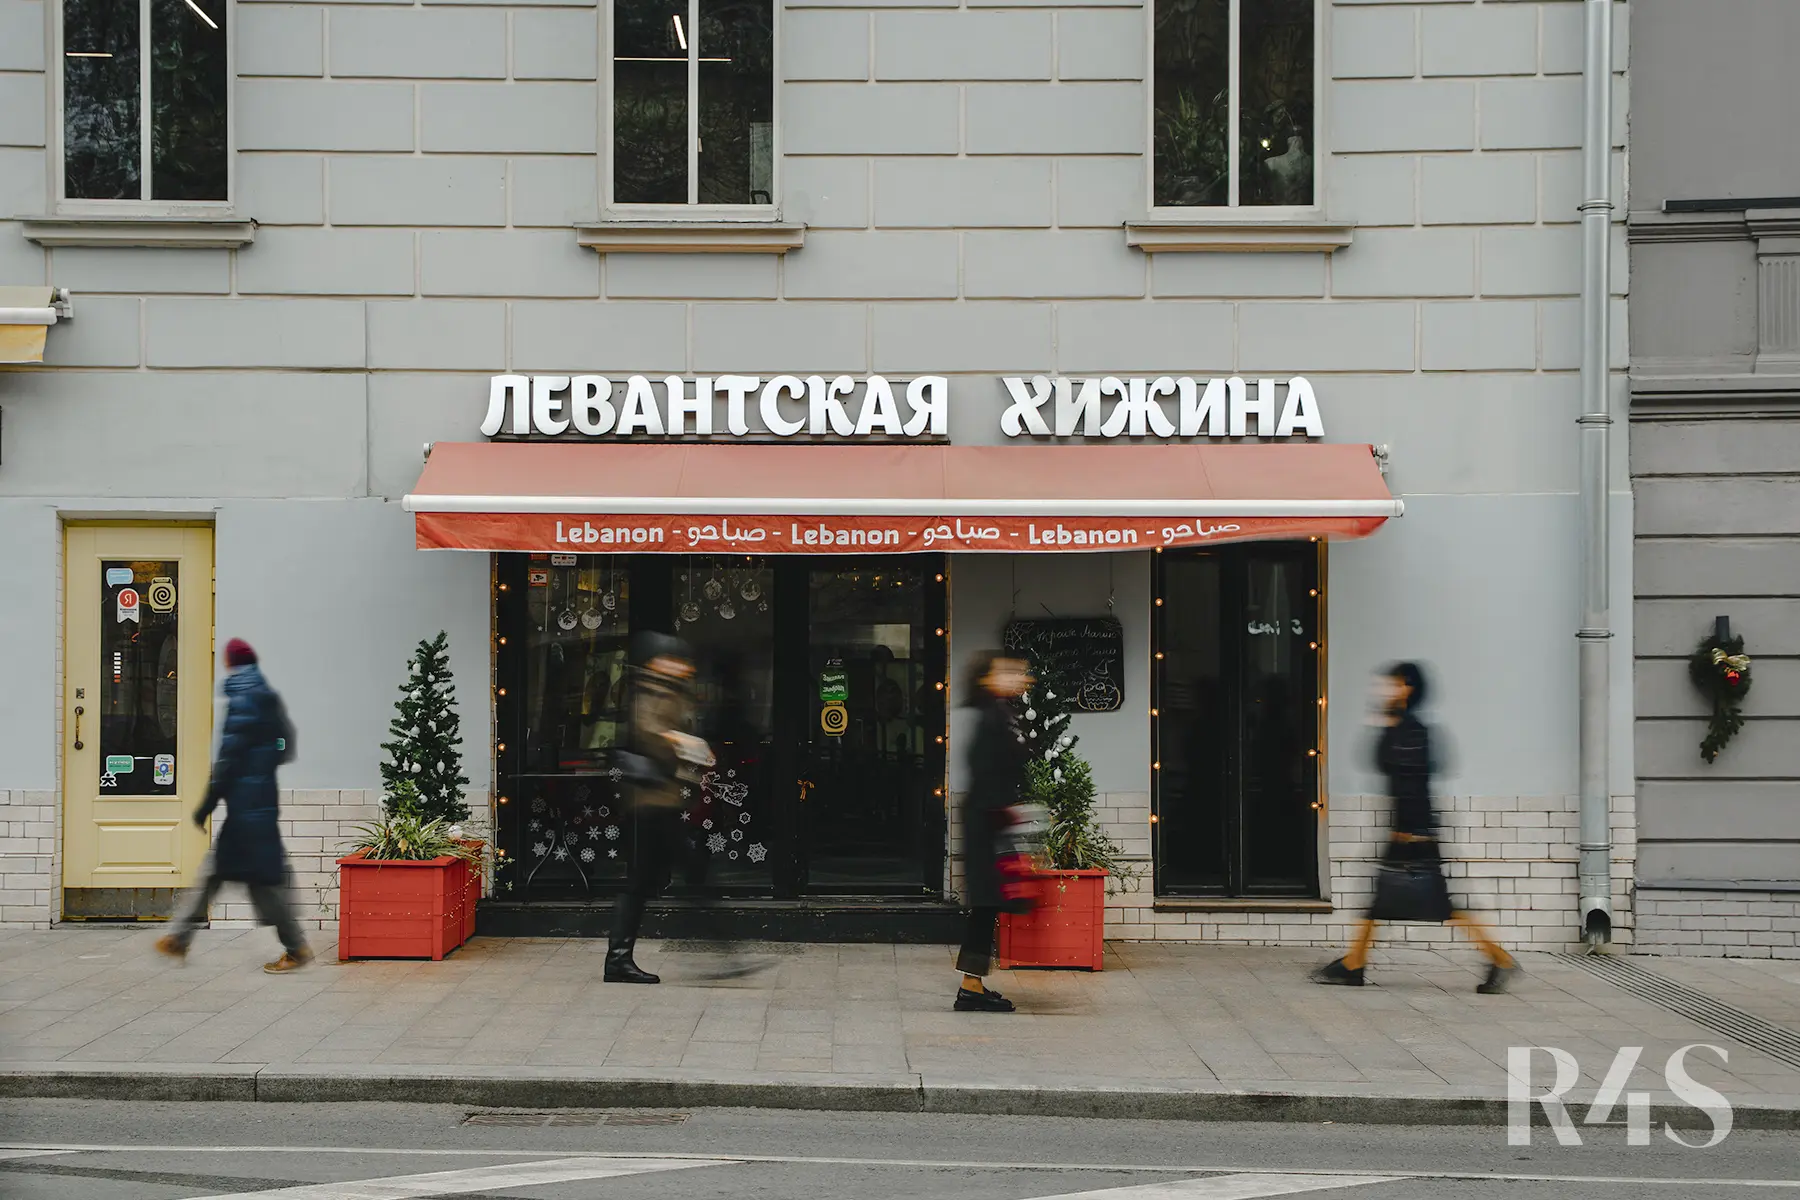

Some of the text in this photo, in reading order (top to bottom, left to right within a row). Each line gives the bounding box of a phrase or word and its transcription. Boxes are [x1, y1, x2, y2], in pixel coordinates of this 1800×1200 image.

[480, 375, 1325, 437] ЛЕВАНТСКАЯ ХИЖИНА
[556, 521, 664, 543] Lebanon
[791, 523, 899, 545] Lebanon
[1028, 524, 1138, 544] Lebanon
